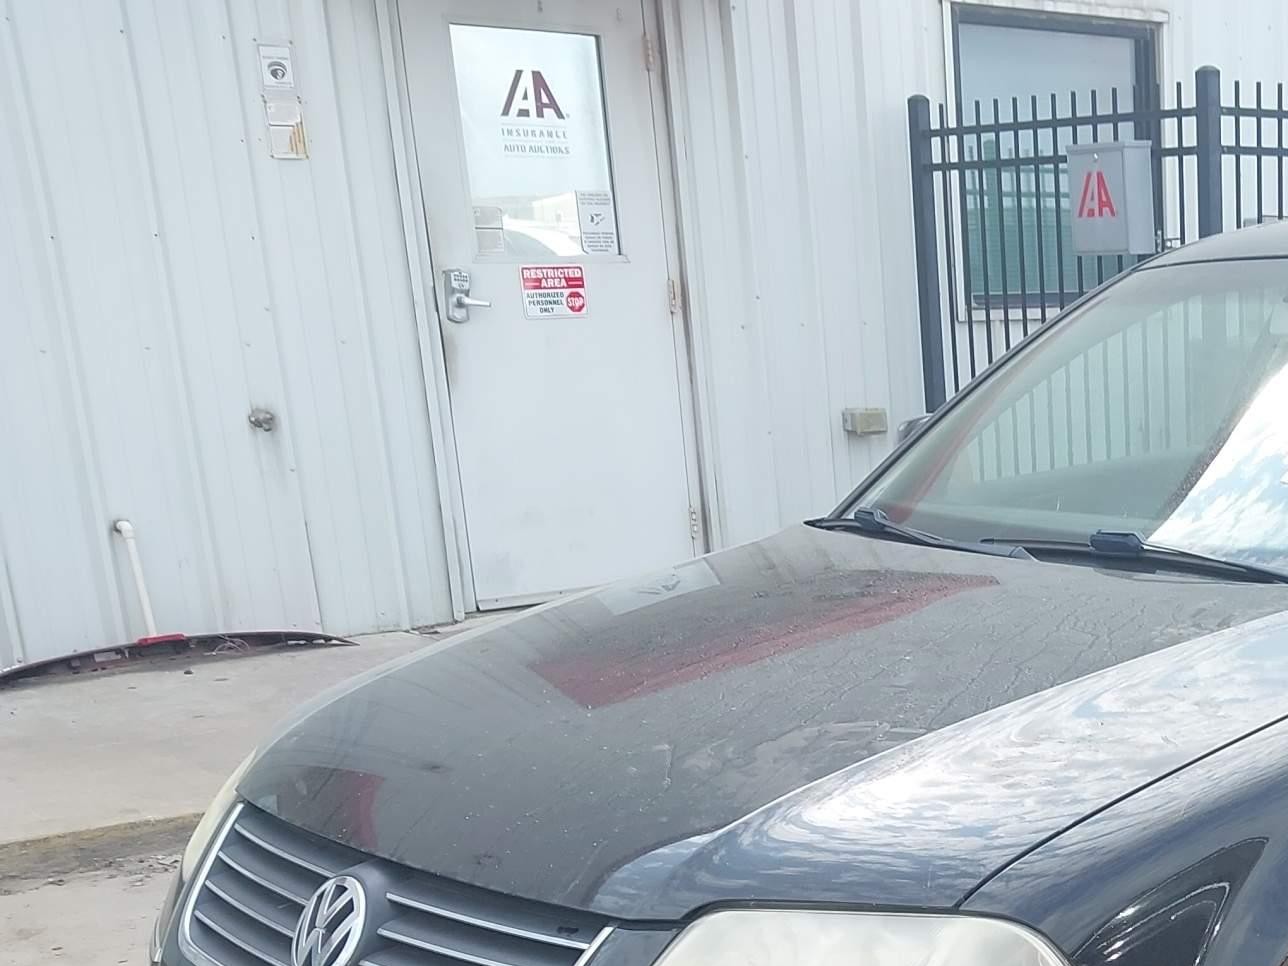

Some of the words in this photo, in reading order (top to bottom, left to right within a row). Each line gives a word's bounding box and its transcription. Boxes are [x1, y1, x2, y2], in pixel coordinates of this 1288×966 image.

[501, 127, 568, 139] INSURANCE
[503, 143, 526, 153] AUTO
[528, 144, 571, 155] AUCTIONS
[523, 267, 582, 279] RESTRICTED
[540, 278, 568, 289] AREA
[526, 291, 565, 299] AUTHORIZED
[528, 298, 564, 307] PERSONNEL
[567, 296, 584, 307] STOP
[539, 306, 554, 314] ONLY
